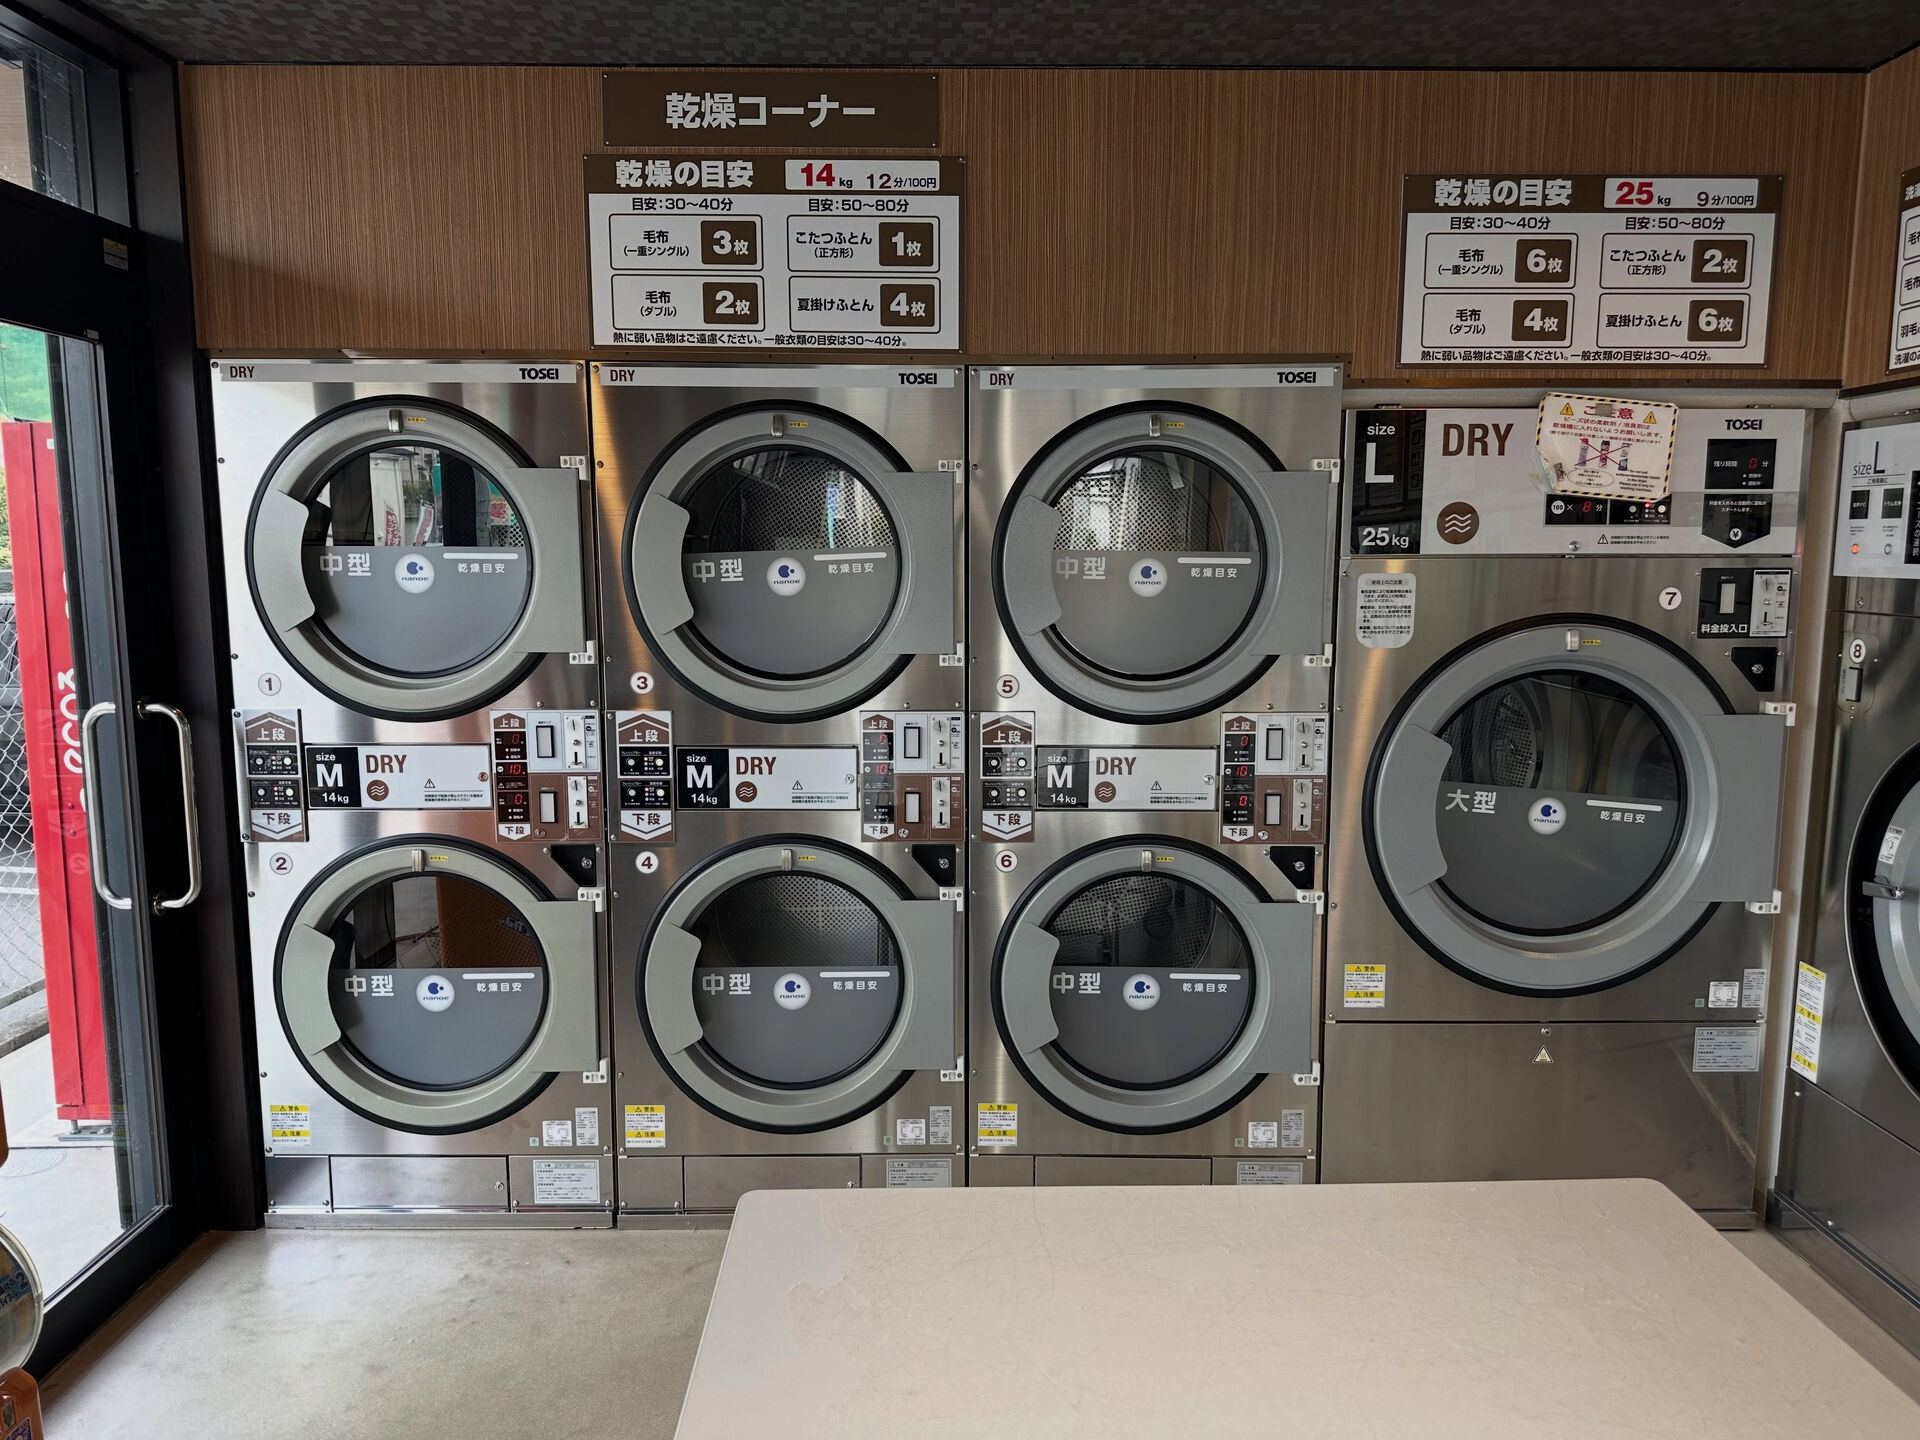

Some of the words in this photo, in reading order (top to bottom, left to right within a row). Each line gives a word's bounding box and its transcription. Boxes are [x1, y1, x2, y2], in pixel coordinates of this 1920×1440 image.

[666, 92, 876, 129] 乾燥コーナー
[615, 160, 754, 189] 乾燥の目安
[800, 163, 836, 187] 14
[839, 177, 853, 190] kg
[1434, 178, 1573, 208] 乾燥の目安
[1615, 182, 1654, 205] 25
[1657, 194, 1671, 207] kg
[643, 230, 669, 244] 毛布
[712, 231, 749, 256] 3枚
[795, 232, 873, 246] こたつふとん
[623, 245, 690, 258] (一重シングル)
[891, 232, 922, 258] 1枚
[814, 246, 855, 259] (正方形)
[1458, 249, 1484, 262] 毛布
[1609, 249, 1687, 263] こたつふとん
[1526, 248, 1563, 274] 6枚
[1701, 249, 1738, 275] 2枚
[1437, 263, 1504, 276] (一重シングル)
[1626, 264, 1667, 277] (正方形)
[645, 291, 671, 304] 毛布
[714, 291, 751, 316] 2枚
[639, 305, 677, 318] (ダブル)
[797, 298, 874, 312] 夏掛けふとん
[889, 293, 926, 318] 4枚
[1455, 309, 1481, 322] 毛布
[1522, 308, 1559, 333] 4枚
[1605, 314, 1682, 328] 夏掛けふとん
[1697, 308, 1734, 333] 6枚
[1448, 323, 1486, 336] (ダブル)
[229, 366, 255, 379] DRY
[519, 367, 559, 380] TOSEI
[610, 369, 635, 382] DRY
[898, 372, 938, 385] TOSEI
[989, 373, 1014, 386] DRY
[1277, 371, 1317, 384] TOSEI
[1583, 404, 1635, 420] ご意
[1367, 423, 1396, 437] size
[1725, 419, 1763, 430] TOSEI
[1441, 423, 1514, 457] DRY
[1364, 442, 1395, 484] L
[1853, 461, 1872, 476] size
[1873, 441, 1886, 475] L
[1596, 504, 1603, 512] 分
[319, 552, 372, 577] 中型
[457, 563, 506, 574] 乾燥目安
[692, 558, 744, 582] 中型
[828, 562, 875, 574] 乾燥目安
[1056, 556, 1106, 580] 中型
[1190, 567, 1237, 578] 乾燥目安
[1666, 591, 1677, 606] 7
[1700, 624, 1748, 634] 料金投入口
[1853, 643, 1862, 659] 8
[265, 677, 273, 691] 1
[636, 676, 648, 689] 3
[1001, 679, 1013, 692] 5
[499, 717, 520, 728] 上段
[868, 718, 889, 729] 上段
[1230, 720, 1251, 731] 上段
[256, 727, 286, 742] 上段
[629, 729, 659, 743] 上段
[993, 730, 1023, 744] 上段
[315, 752, 336, 762] size
[365, 754, 407, 774] DRY
[686, 753, 707, 763] size
[1047, 753, 1067, 763] size
[736, 756, 777, 775] DRY
[1095, 756, 1137, 776] DRY
[316, 764, 345, 788] M
[687, 764, 713, 789] M
[1047, 765, 1073, 789] M
[1444, 788, 1498, 815] 大型
[262, 812, 292, 826] 下段
[632, 813, 661, 826] 下段
[993, 813, 1022, 826] 下段
[1599, 810, 1647, 824] 乾燥目安
[504, 825, 525, 836] 下段
[869, 825, 889, 836] 下段
[1228, 827, 1249, 837] 下段
[275, 857, 288, 870] 2
[641, 856, 653, 869] 4
[1000, 855, 1012, 868] 6
[344, 974, 395, 997] 中型
[476, 982, 523, 993] 乾燥目安
[702, 973, 752, 996] 中型
[832, 980, 878, 991] 乾燥目安
[1052, 971, 1102, 995] 中型
[1182, 982, 1228, 993] 乾燥目安
